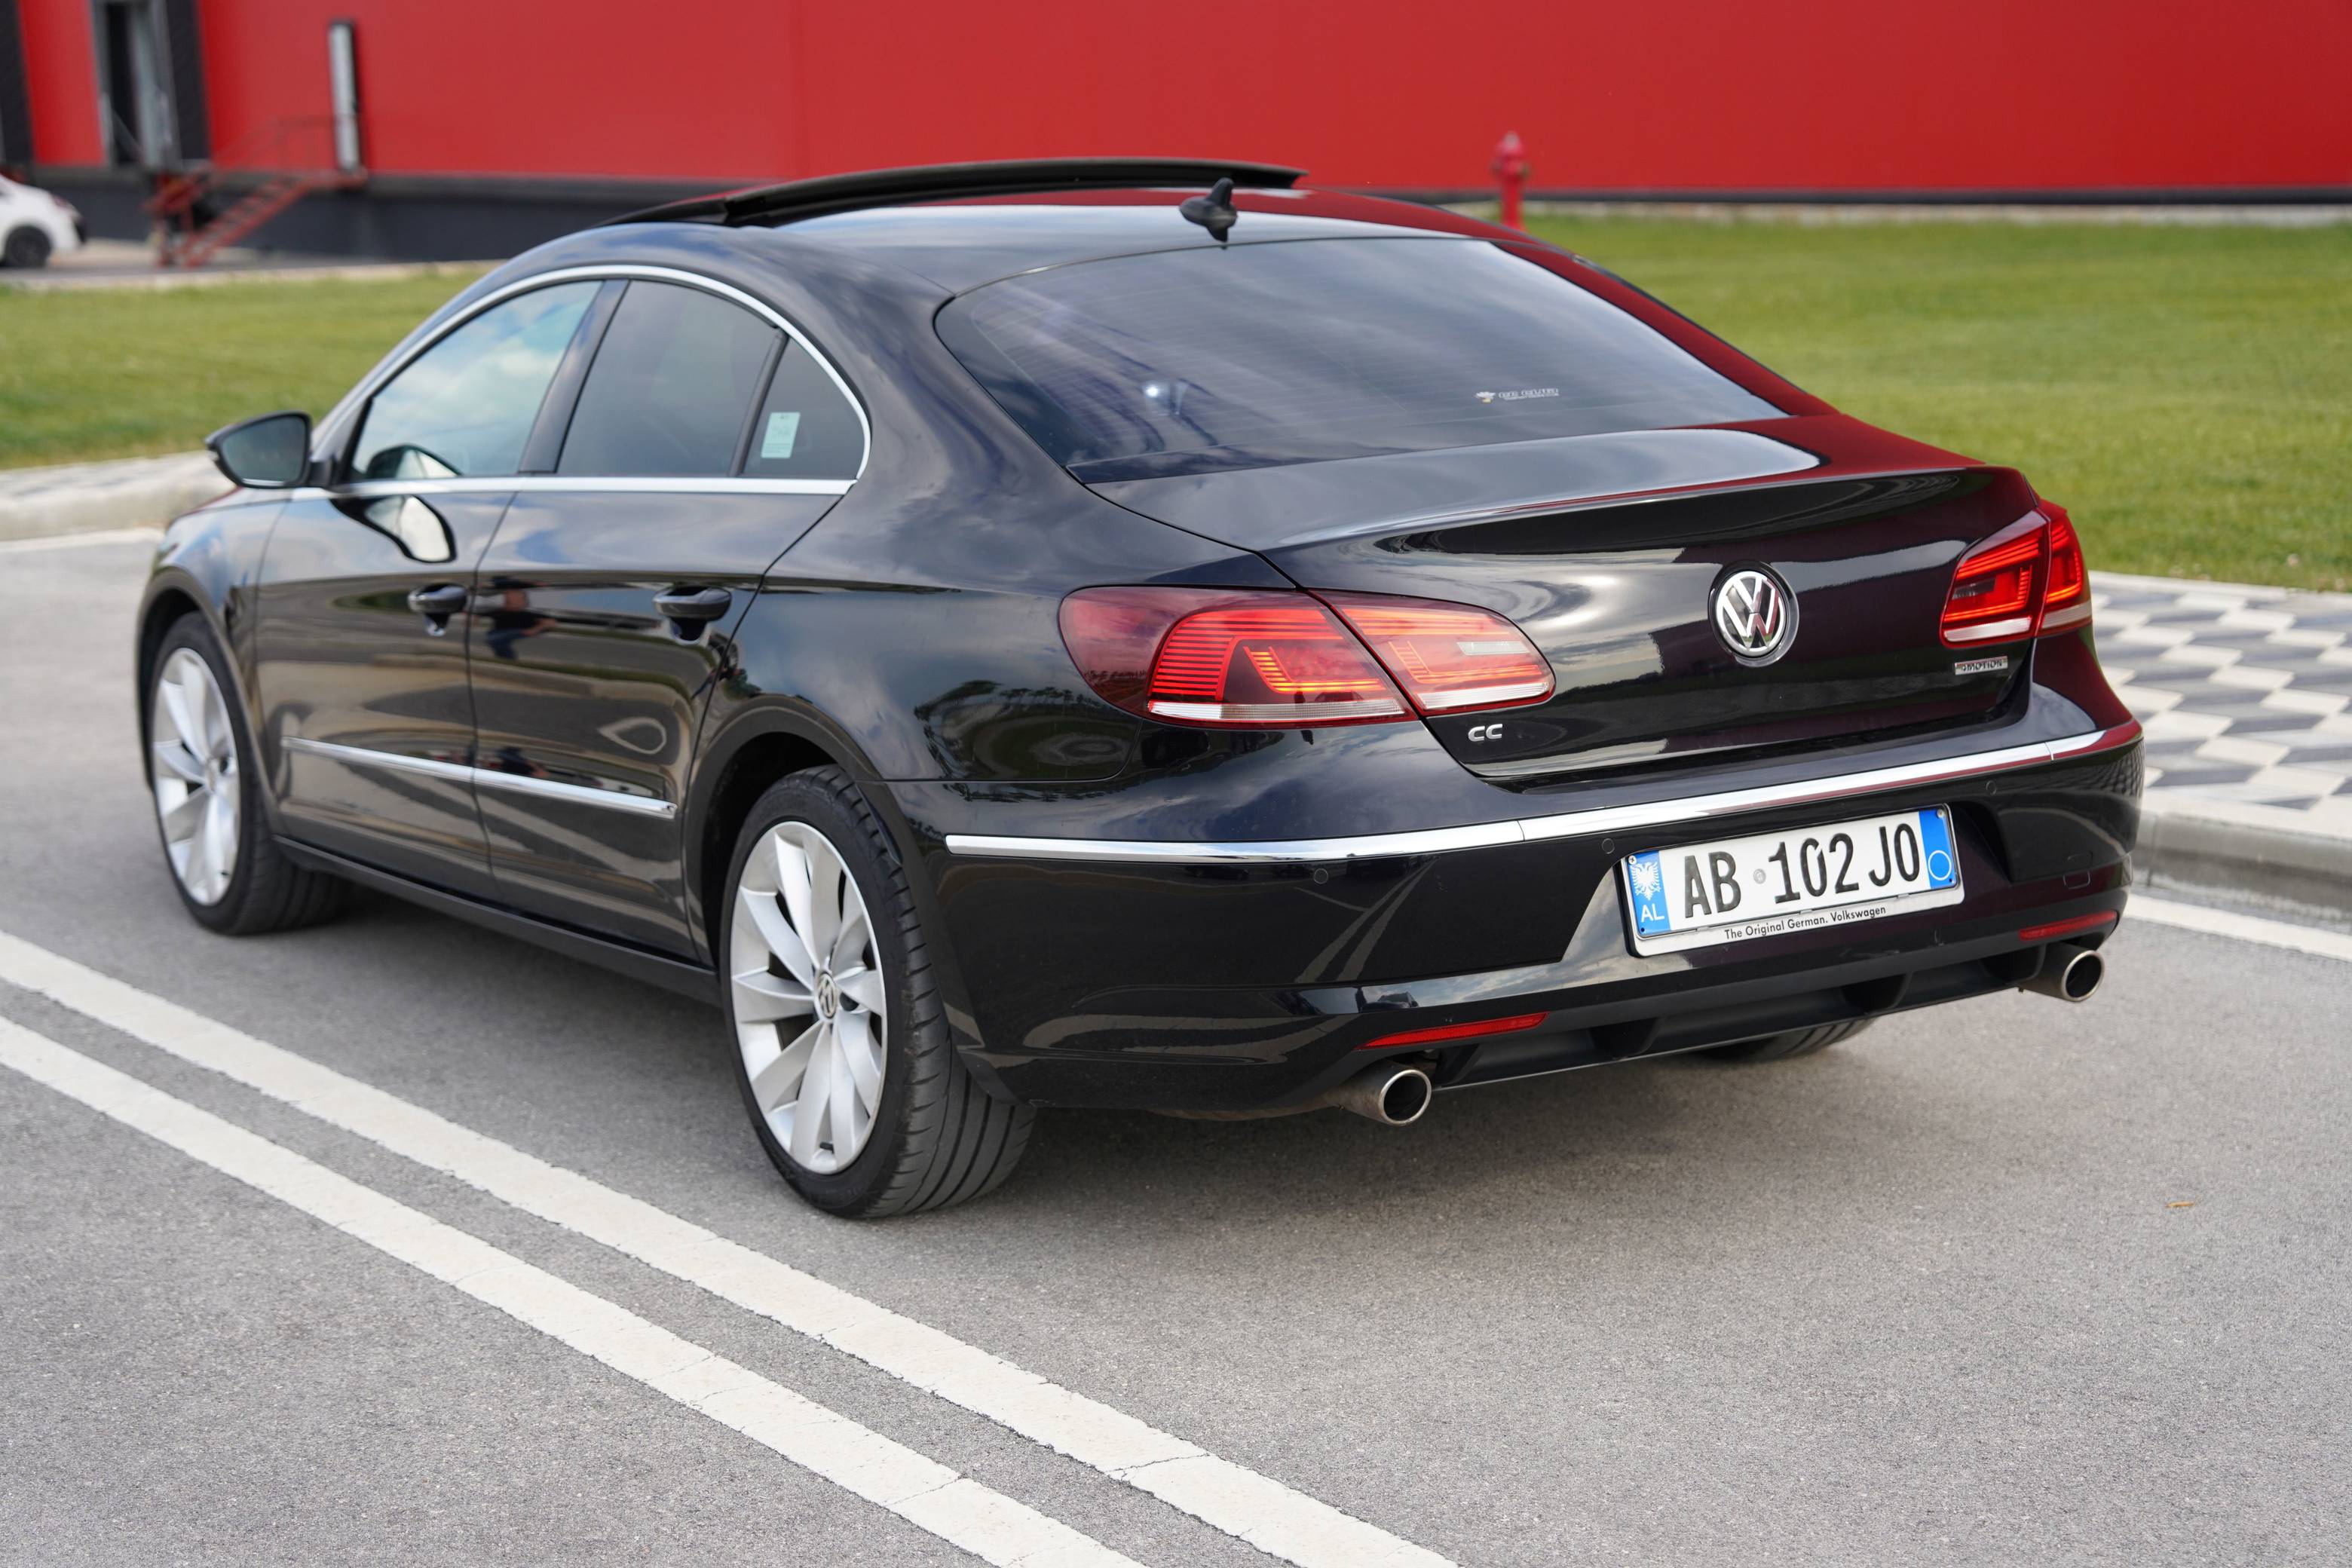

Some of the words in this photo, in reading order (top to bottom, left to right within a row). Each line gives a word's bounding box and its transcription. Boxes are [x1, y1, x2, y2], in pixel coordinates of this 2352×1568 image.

[1468, 724, 1503, 742] CC
[1684, 851, 1741, 918] AB
[1768, 832, 1860, 904] 102
[1640, 903, 1665, 923] AL
[1724, 928, 1742, 939] The
[1745, 920, 1784, 936] Original
[1787, 916, 1828, 929] German.
[1830, 906, 1886, 923] Volkswagen
